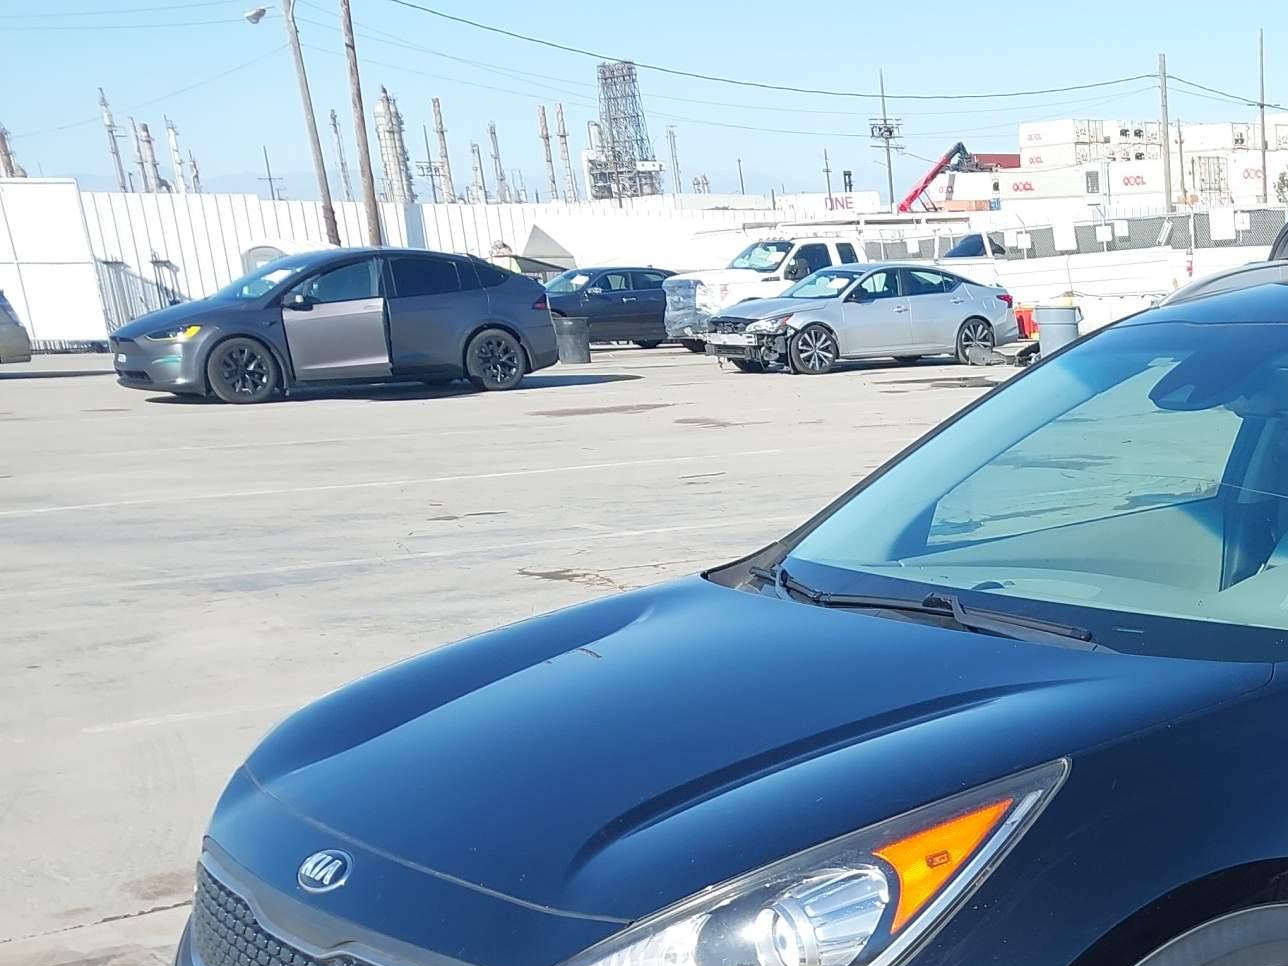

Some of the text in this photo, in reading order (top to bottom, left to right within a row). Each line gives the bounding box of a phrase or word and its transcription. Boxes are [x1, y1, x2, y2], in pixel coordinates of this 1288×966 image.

[1242, 167, 1264, 180] OOC
[1012, 180, 1035, 192] OOCL
[1123, 175, 1147, 187] OOCL
[300, 852, 343, 886] KIA
